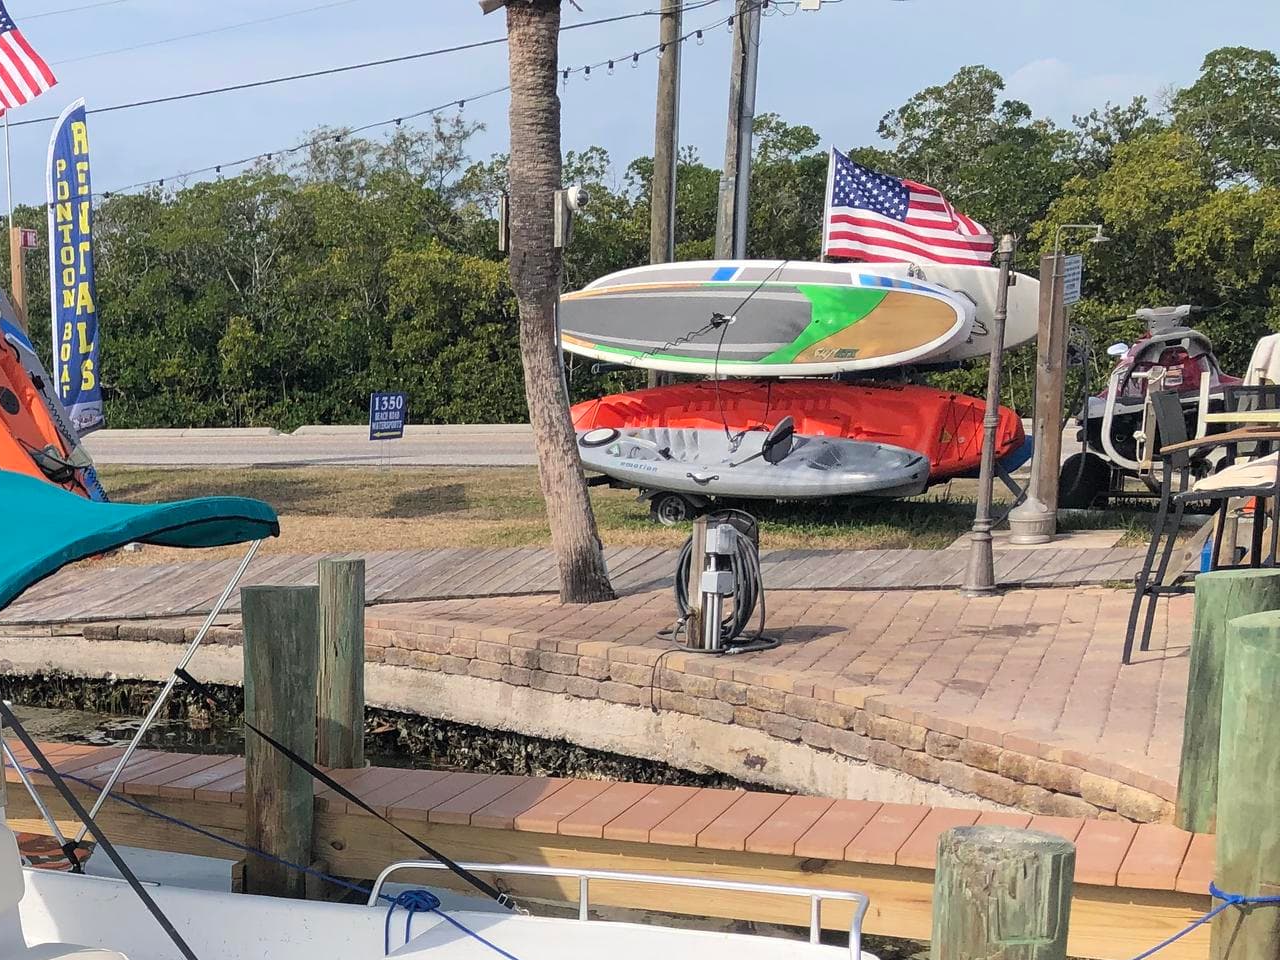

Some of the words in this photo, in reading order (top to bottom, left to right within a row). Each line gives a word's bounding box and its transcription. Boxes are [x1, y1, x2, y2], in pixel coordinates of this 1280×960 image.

[55, 159, 76, 309] PONTOON
[71, 120, 95, 391] RENTALS
[60, 321, 72, 399] BOAT
[375, 395, 403, 410] 1350
